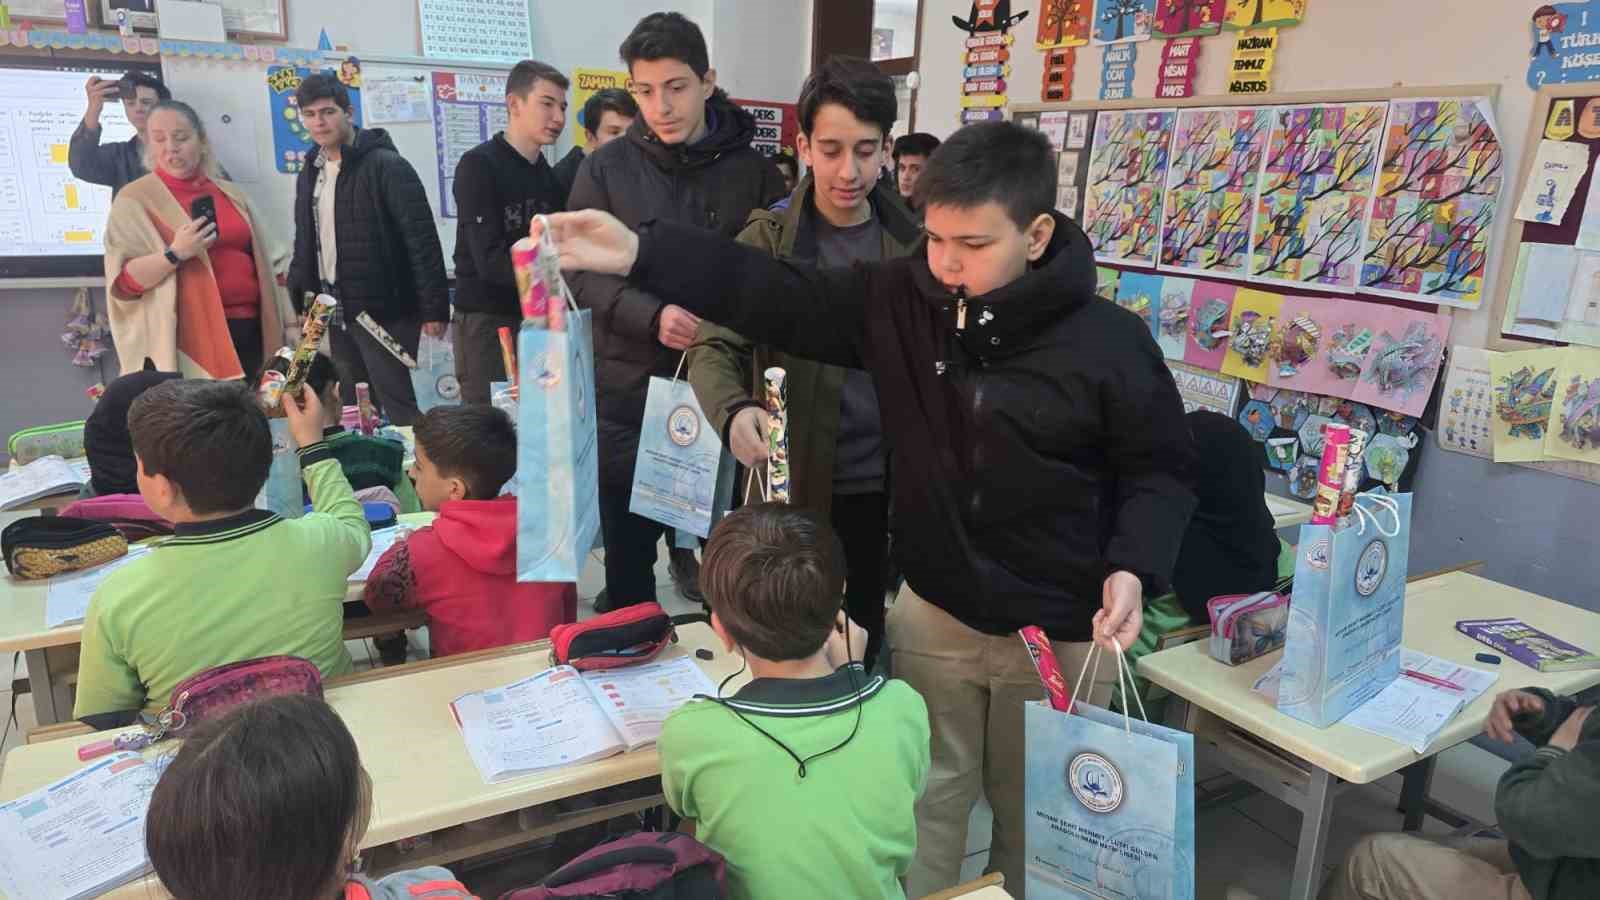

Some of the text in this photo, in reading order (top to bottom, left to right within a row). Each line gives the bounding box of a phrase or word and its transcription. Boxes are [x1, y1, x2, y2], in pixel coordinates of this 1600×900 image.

[1237, 36, 1273, 50] HAZİRAN
[1169, 44, 1191, 57] MART
[1164, 64, 1188, 77] NİSAN
[1233, 59, 1265, 71] TEMMUZ
[1230, 80, 1267, 93] AĞUSTOS
